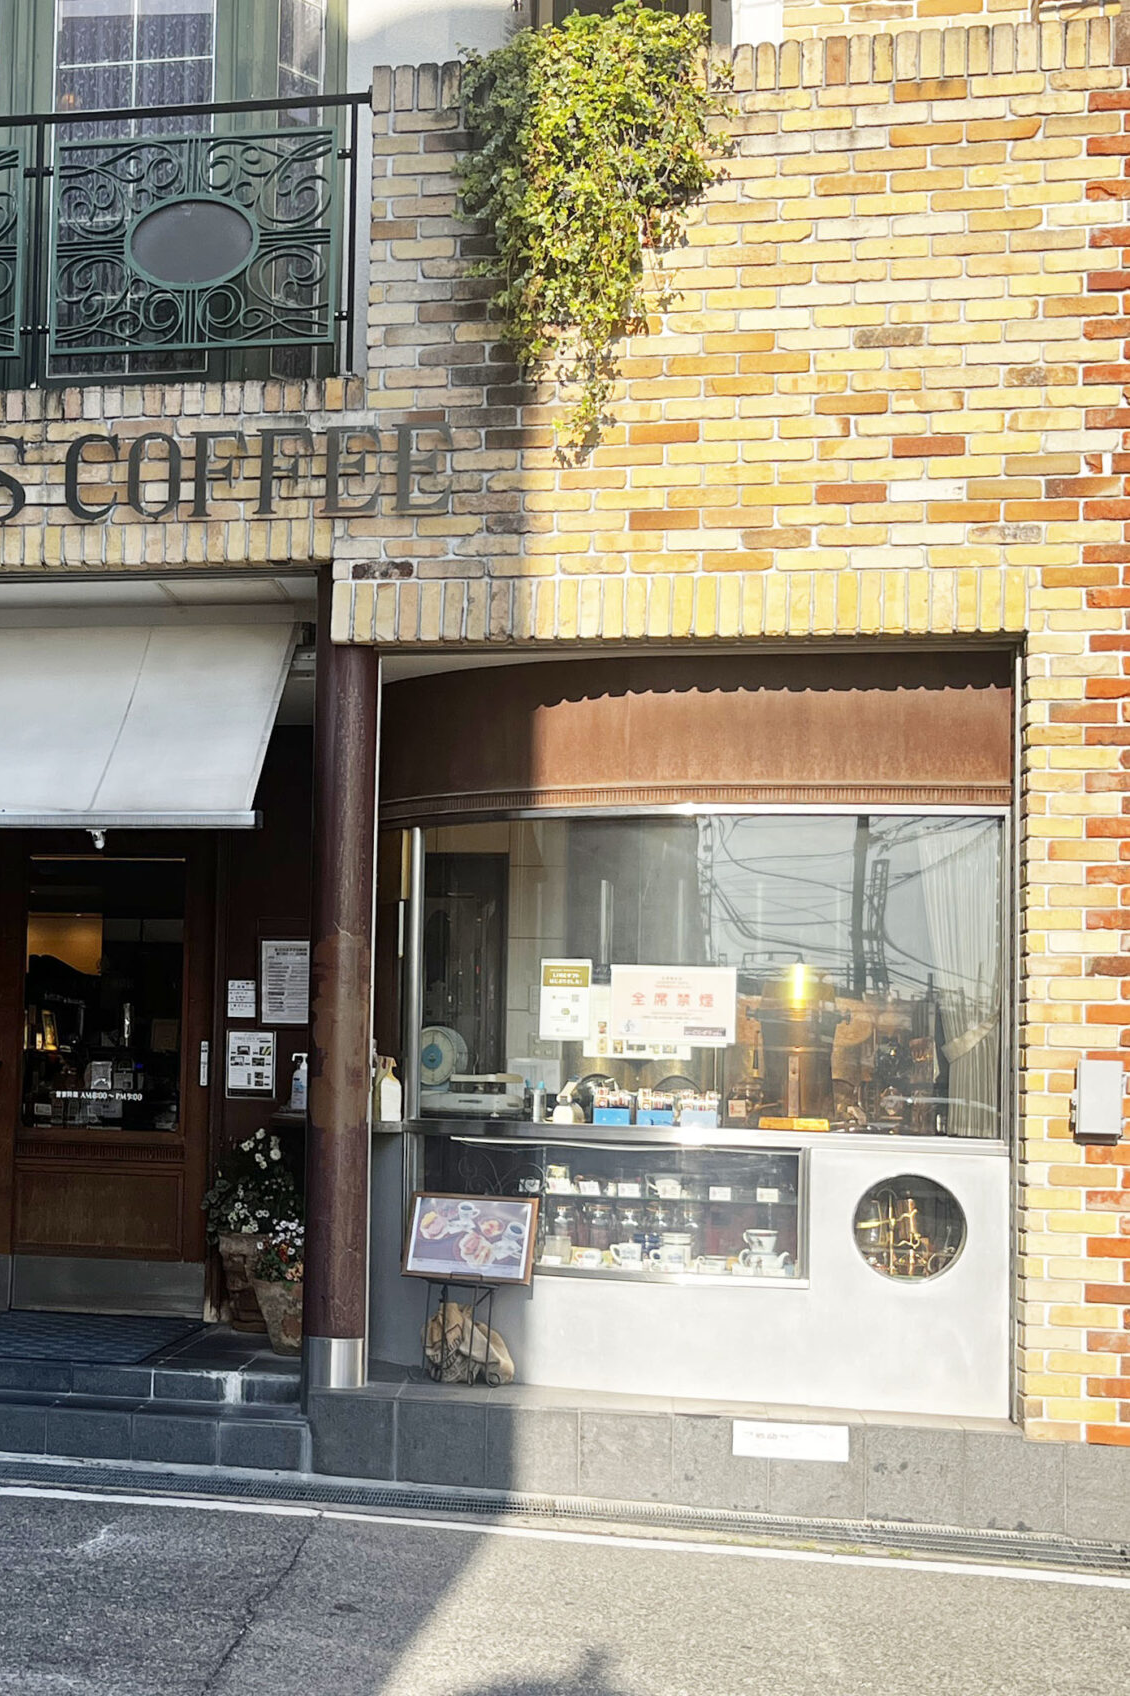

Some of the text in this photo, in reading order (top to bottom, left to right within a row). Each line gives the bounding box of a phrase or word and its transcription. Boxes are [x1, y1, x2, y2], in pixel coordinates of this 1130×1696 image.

[64, 420, 455, 521] COFFEE
[631, 992, 714, 1008] 全席禁煙
